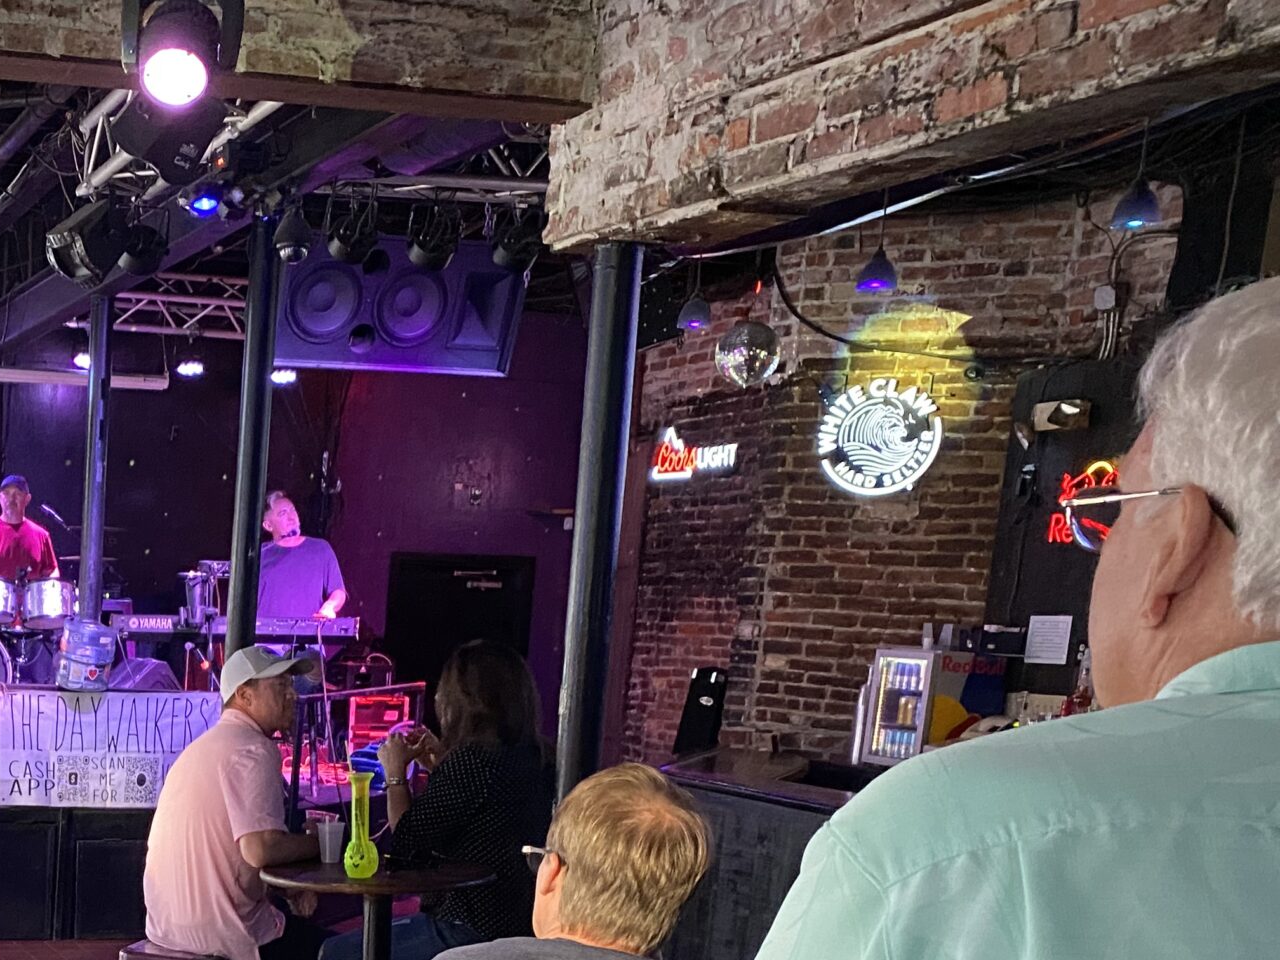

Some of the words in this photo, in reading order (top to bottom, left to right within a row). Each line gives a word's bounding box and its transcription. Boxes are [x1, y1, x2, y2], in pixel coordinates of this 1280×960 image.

[817, 384, 865, 455] WHITE
[869, 378, 939, 417] CLAW
[657, 443, 698, 472] Coors
[696, 443, 738, 469] LIGHT
[833, 461, 877, 488] HARD
[882, 429, 935, 487] SELTZER
[139, 618, 173, 629] YAMAHA
[941, 655, 973, 675] Red
[8, 693, 46, 752] THE
[8, 759, 56, 780] CASH
[91, 756, 126, 771] SCAN
[9, 779, 56, 797] APP
[99, 775, 116, 787] ME
[92, 788, 118, 802] FOR
